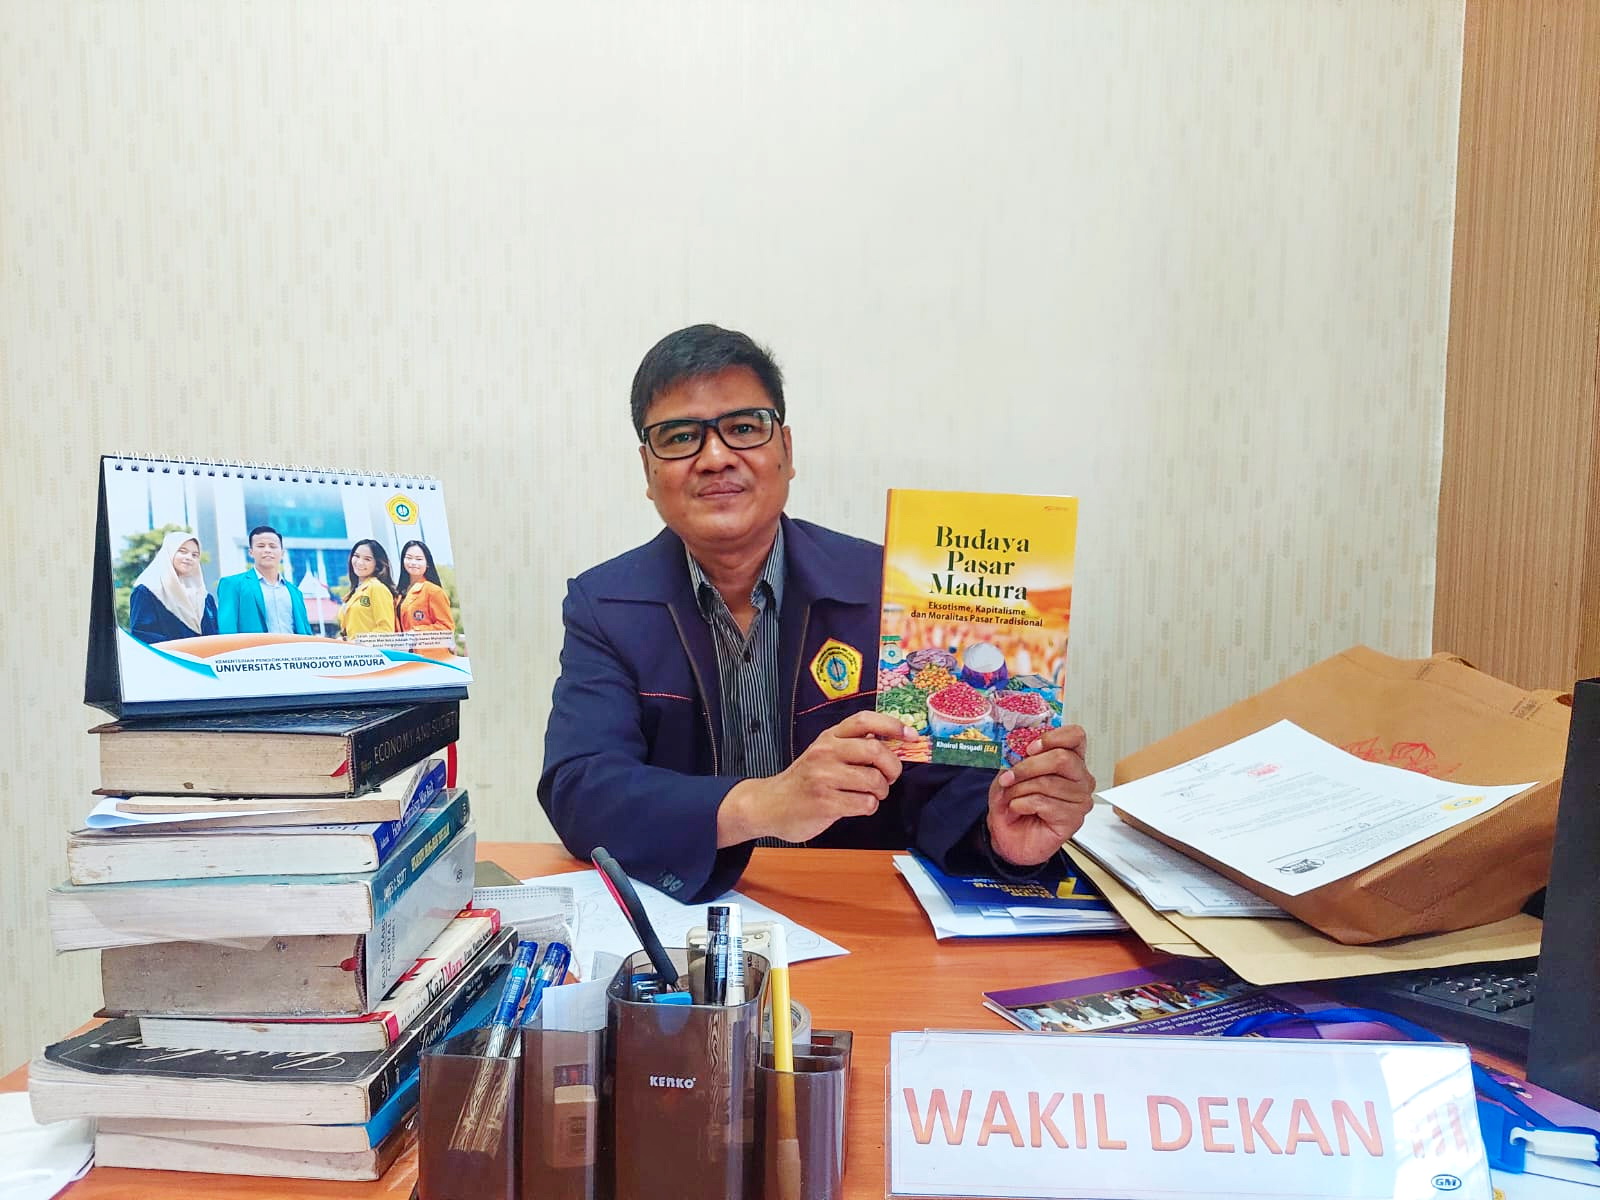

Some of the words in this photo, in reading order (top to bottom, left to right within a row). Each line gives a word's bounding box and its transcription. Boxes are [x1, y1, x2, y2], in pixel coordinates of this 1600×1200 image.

[935, 525, 1030, 554] Budaya
[947, 550, 1016, 575] Pasar
[928, 573, 1028, 601] Madura
[911, 610, 927, 619] dan
[928, 612, 968, 623] Moralitas
[969, 615, 994, 624] Pasar
[995, 616, 1043, 628] Tradisional
[928, 601, 974, 614] Eksotisme,
[975, 605, 1026, 617] Kapitalisme
[216, 662, 281, 673] UNIVERSITAS
[283, 660, 342, 671] TRUNOJOYO
[344, 658, 386, 668] MADURA
[426, 969, 446, 1002] Karl
[443, 959, 463, 980] Marx
[649, 1075, 695, 1089] KENKO
[903, 1087, 1128, 1151] WAKIL
[1147, 1094, 1384, 1157] DEKAN
